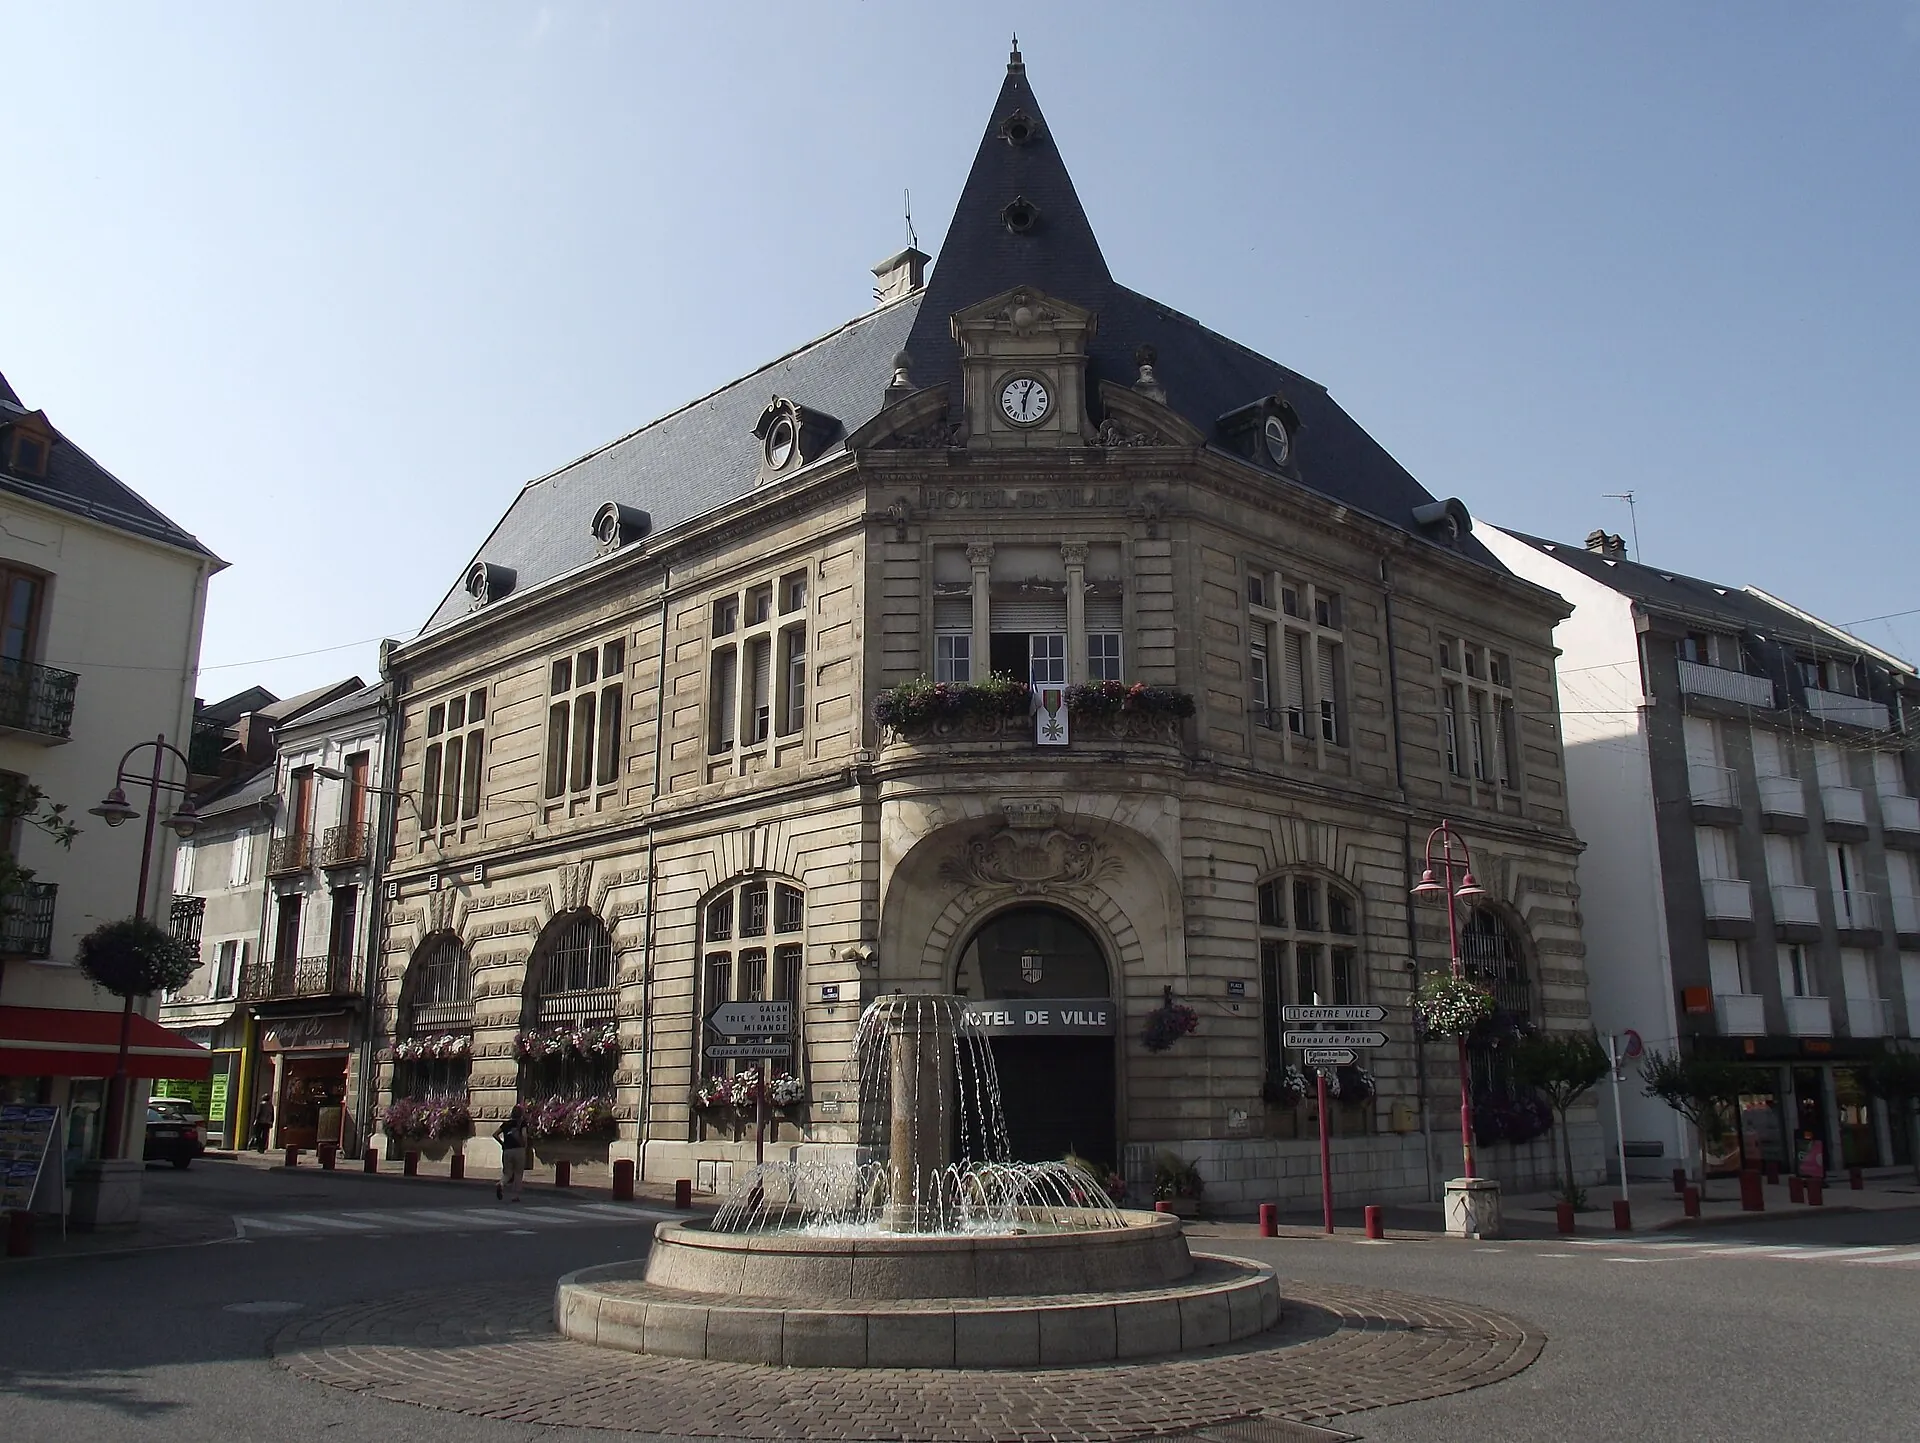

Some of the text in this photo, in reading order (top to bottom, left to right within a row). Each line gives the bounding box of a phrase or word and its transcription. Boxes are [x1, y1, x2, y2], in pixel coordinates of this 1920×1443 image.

[760, 1014, 788, 1022] BAISE
[1025, 1010, 1050, 1026] DE
[1060, 1011, 1107, 1026] VILLE
[1302, 1009, 1340, 1018] CENTRE
[1345, 1009, 1371, 1018] VILLE
[744, 1024, 788, 1032] MIRANDE
[1290, 1035, 1372, 1044] Bureau de Poste
[712, 1047, 738, 1056] Espace
[740, 1047, 749, 1055] du
